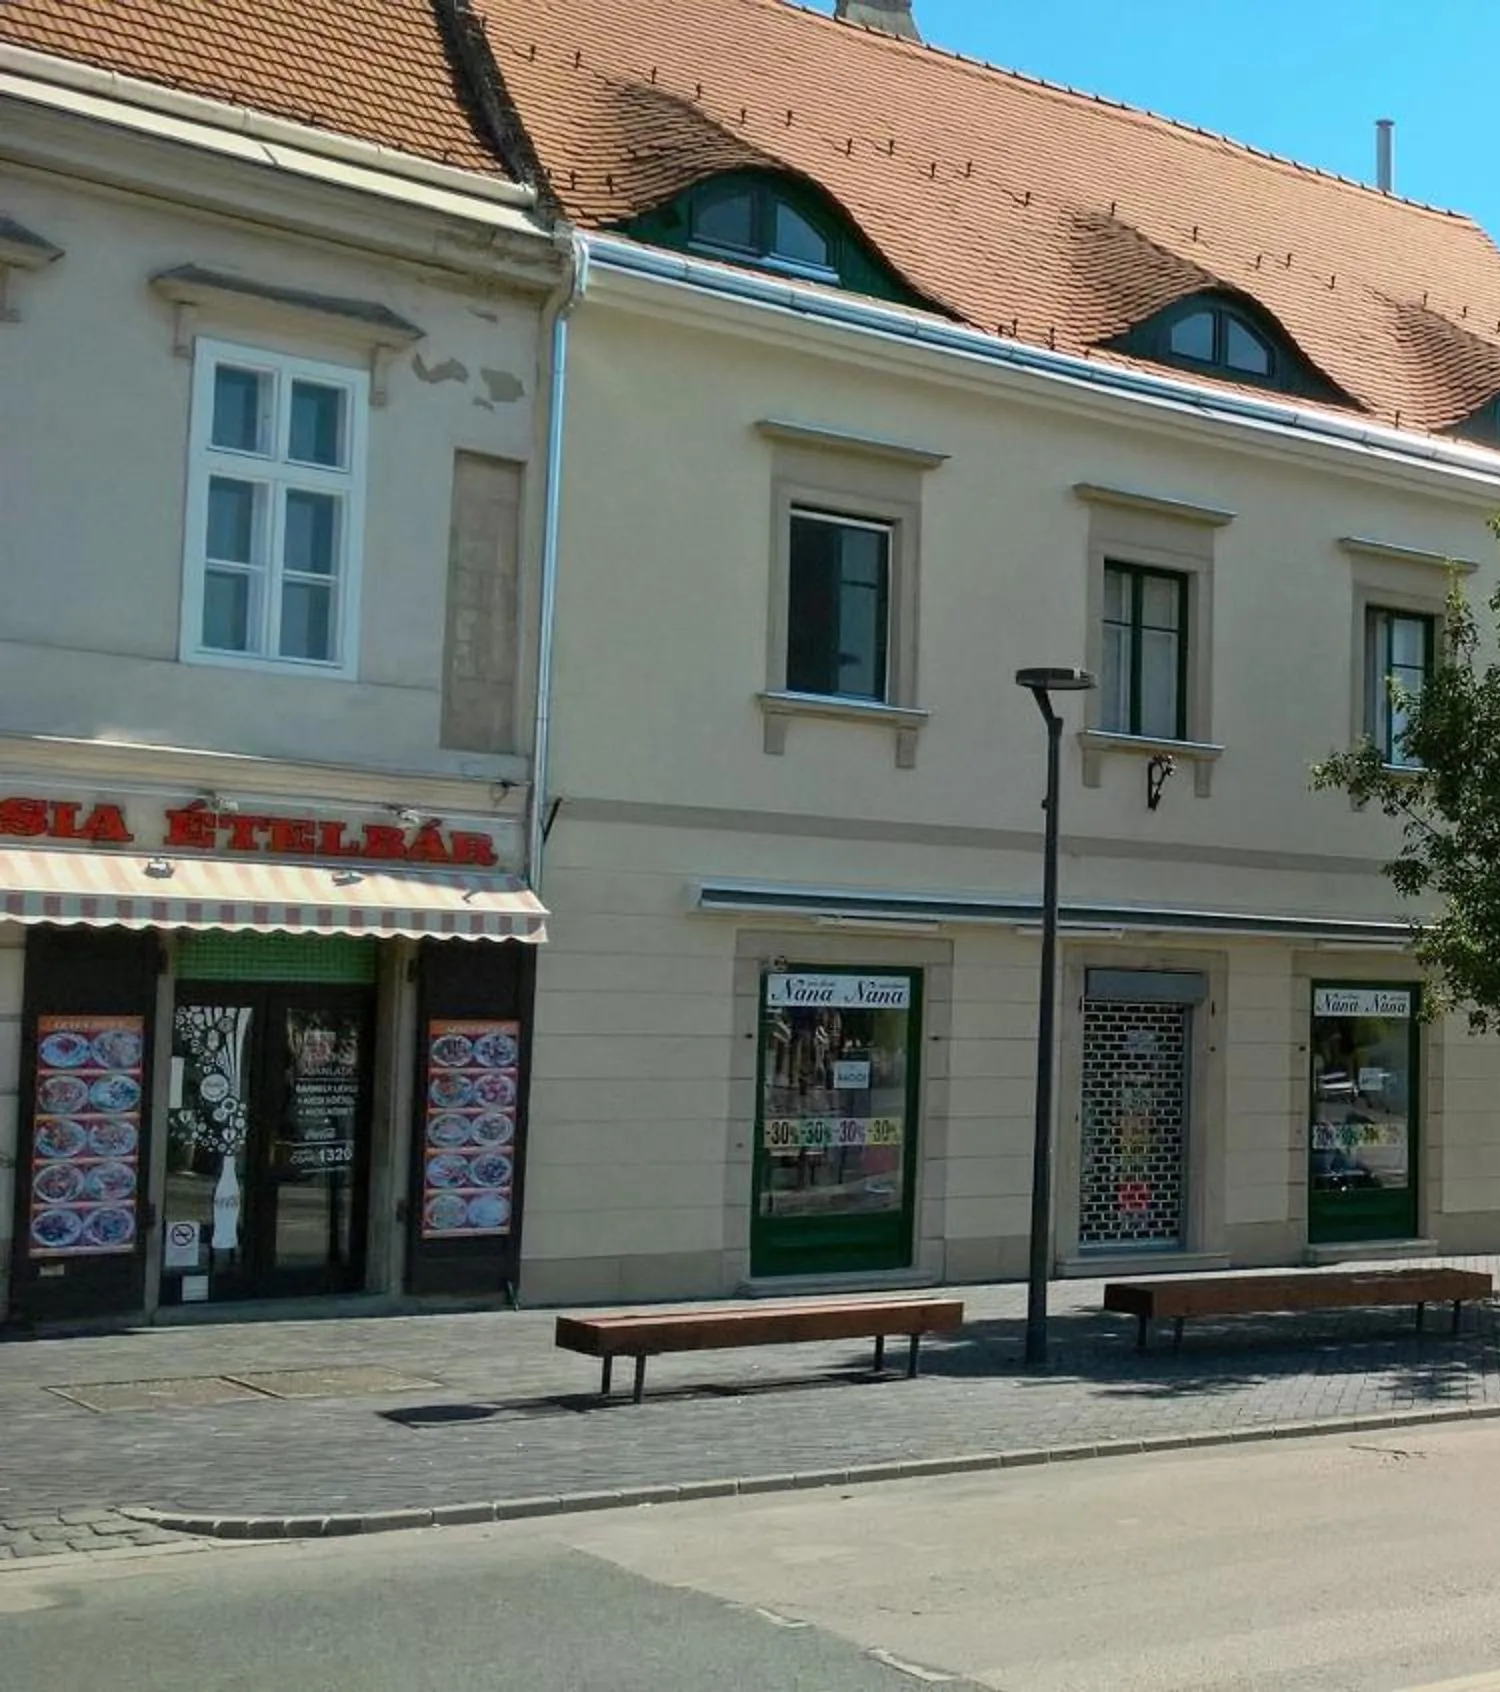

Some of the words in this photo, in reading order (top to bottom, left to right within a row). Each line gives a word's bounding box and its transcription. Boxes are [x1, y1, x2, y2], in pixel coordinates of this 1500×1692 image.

[163, 797, 498, 866] ÉTELBÁR
[771, 980, 833, 1001] Nana
[844, 980, 903, 1003] Nana
[1316, 993, 1359, 1012] Nana
[1364, 994, 1406, 1012] Nana
